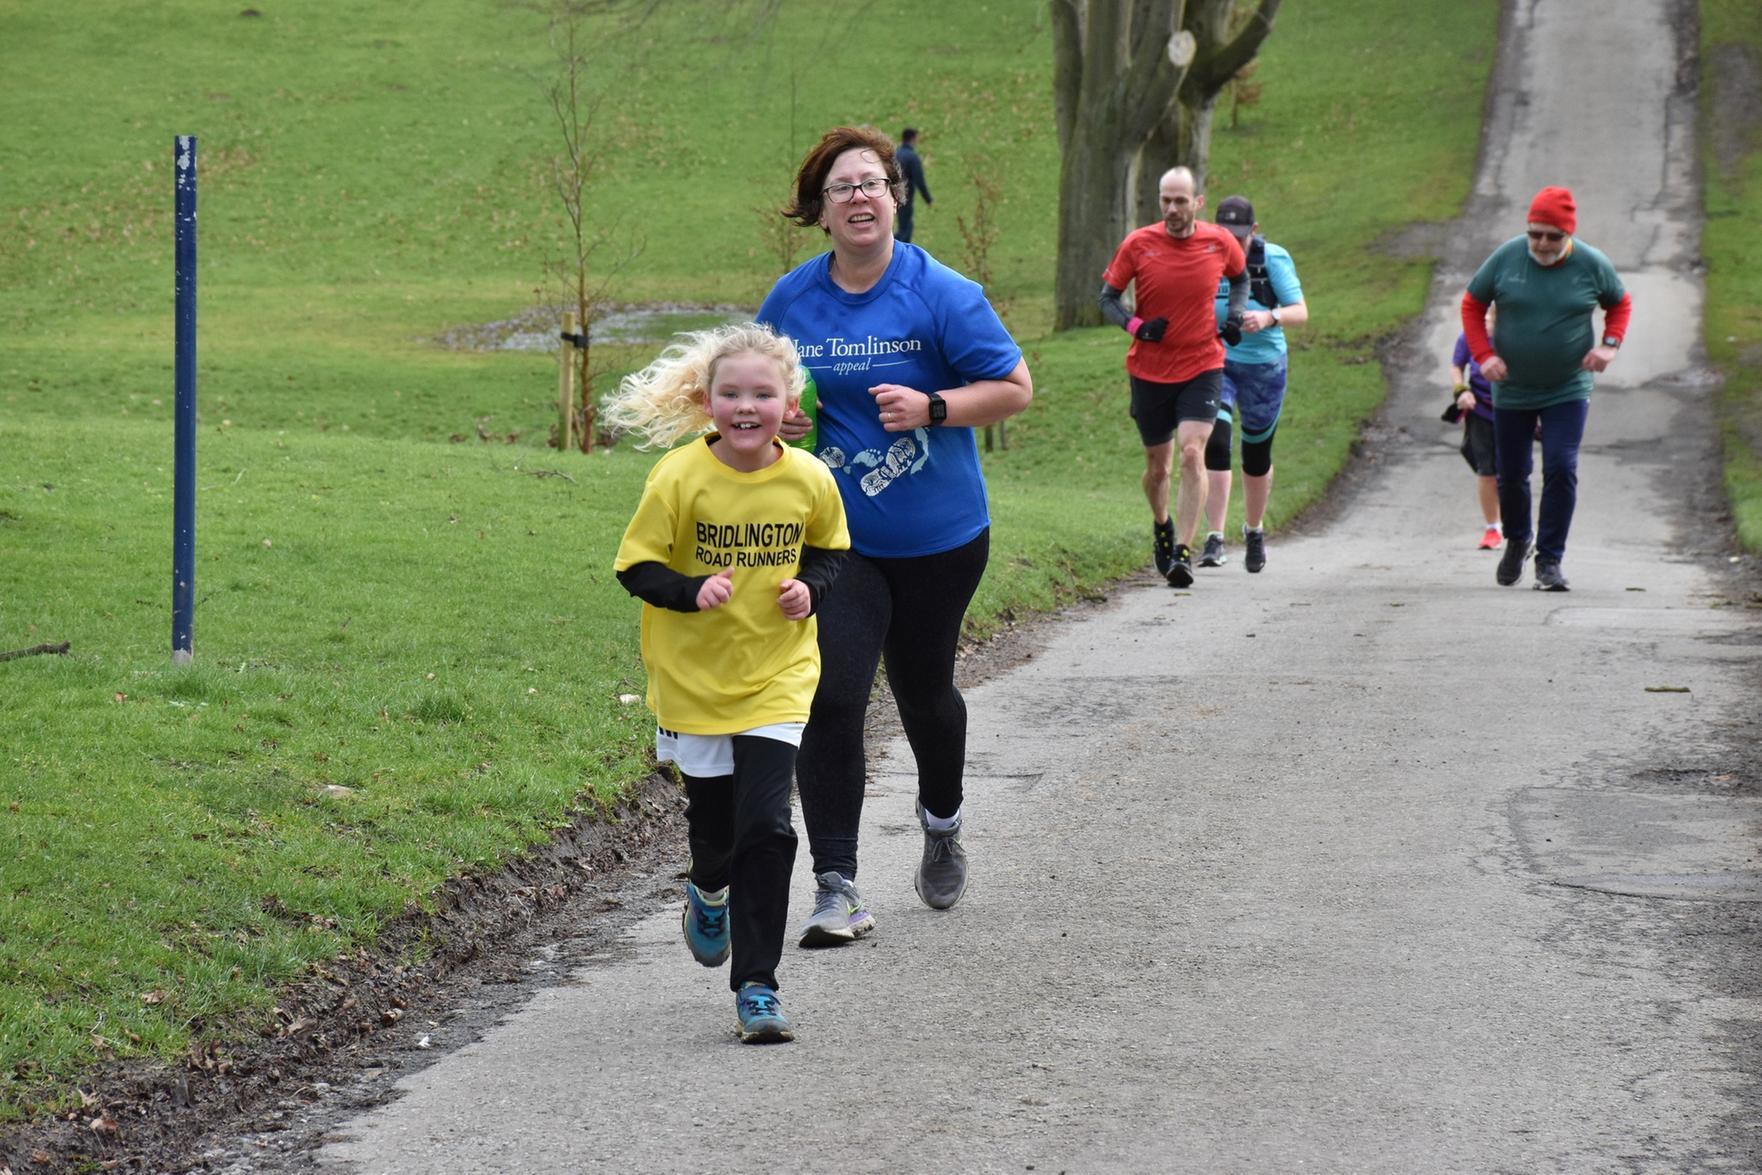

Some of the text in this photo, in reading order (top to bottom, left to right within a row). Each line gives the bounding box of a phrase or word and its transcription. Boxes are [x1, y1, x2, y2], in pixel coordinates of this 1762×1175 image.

[825, 335, 921, 357] Tomlinson
[833, 357, 871, 375] appeal
[696, 521, 804, 549] BRIDLINGTON
[695, 545, 797, 568] ROAD RUNNERS
